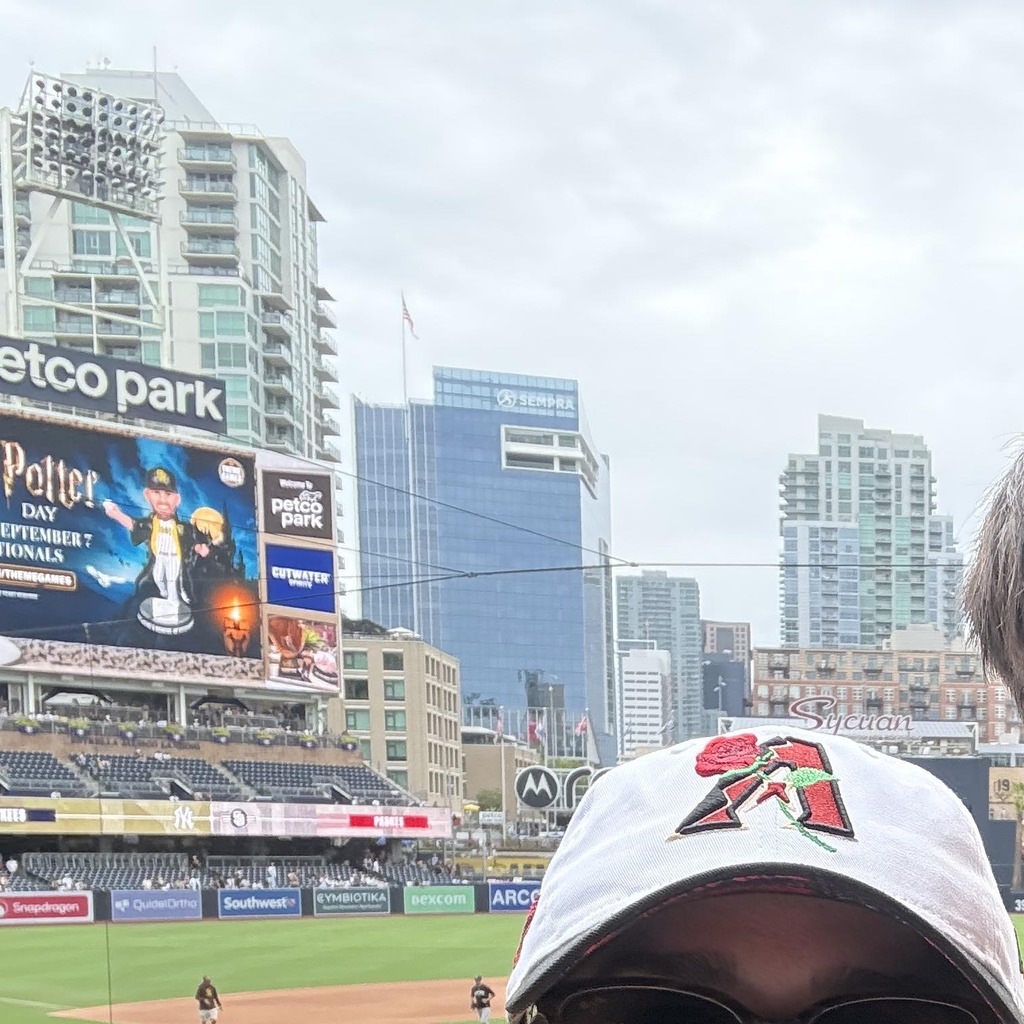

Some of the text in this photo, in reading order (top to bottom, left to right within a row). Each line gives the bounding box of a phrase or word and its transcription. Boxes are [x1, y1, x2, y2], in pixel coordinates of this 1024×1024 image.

[115, 368, 224, 422] park
[519, 394, 576, 411] SEMPRA
[1, 440, 99, 510] Potter
[21, 502, 58, 523] DAY
[271, 498, 323, 515] petco
[281, 511, 323, 529] park
[84, 533, 93, 548] 7
[271, 566, 331, 585] CUTWATER
[788, 696, 915, 735] Sycuan
[997, 778, 1010, 792] 19
[12, 901, 80, 914] Snapdragon
[224, 896, 288, 910] Southwest
